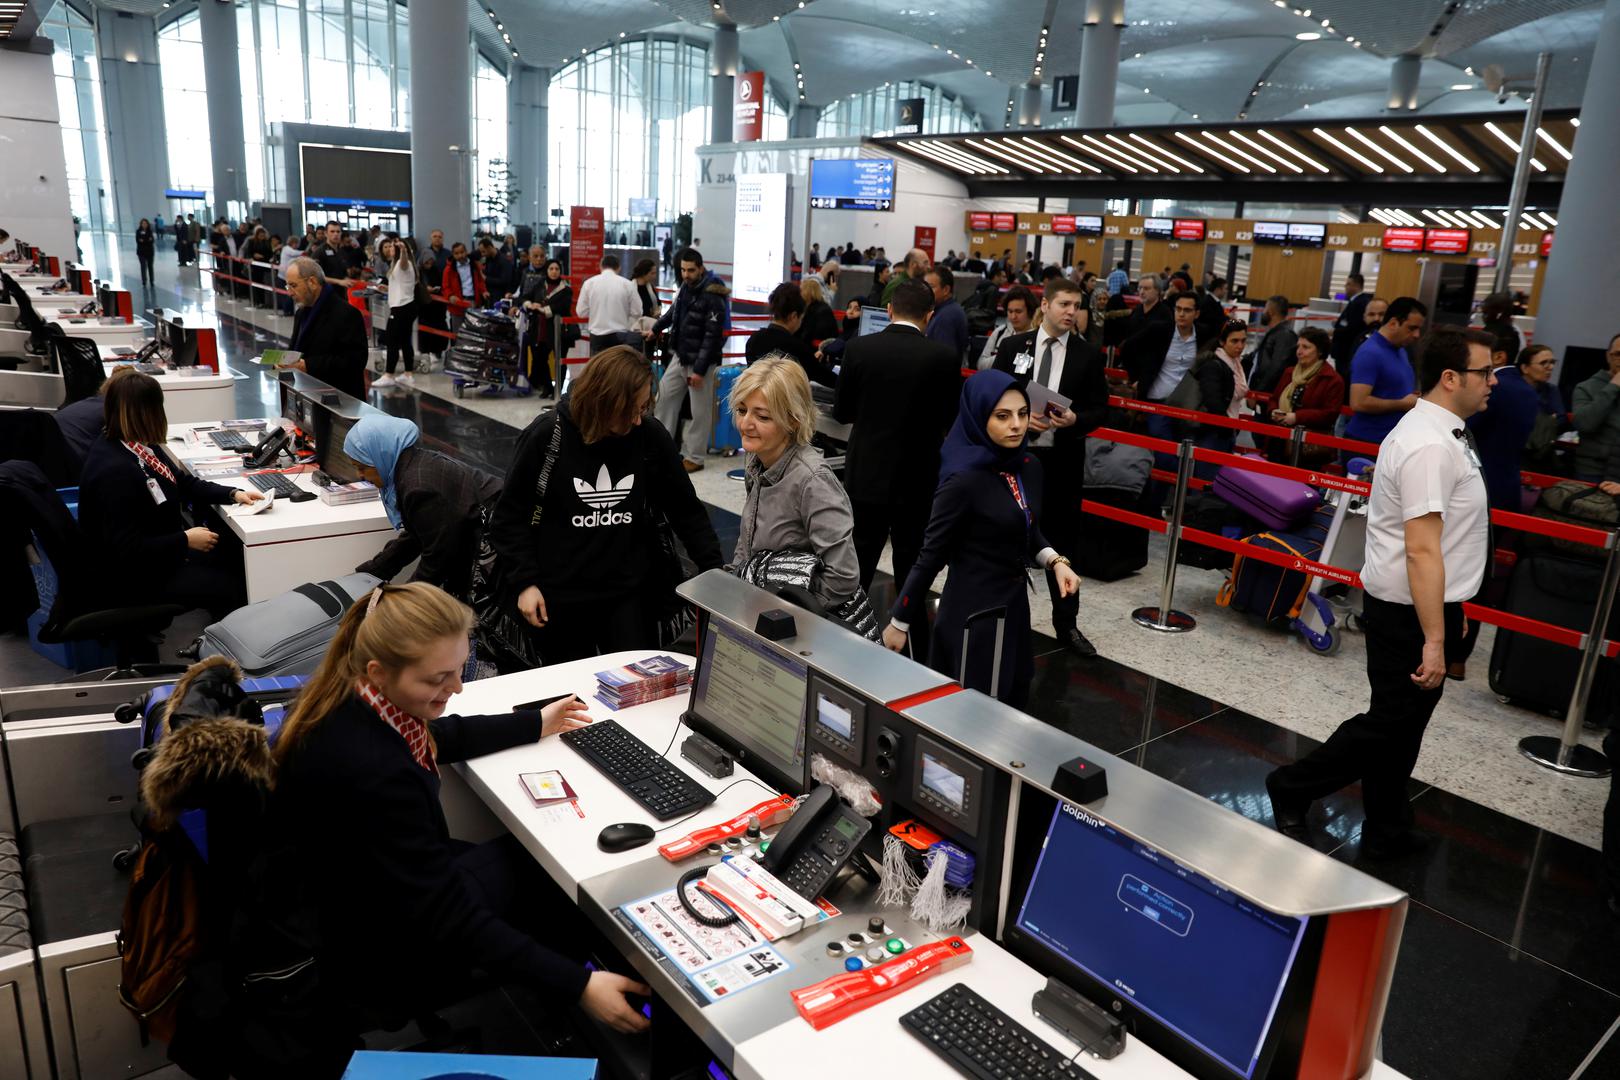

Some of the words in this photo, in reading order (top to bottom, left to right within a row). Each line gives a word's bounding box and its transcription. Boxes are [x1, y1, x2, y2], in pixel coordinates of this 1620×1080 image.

[1057, 80, 1070, 107] L
[701, 158, 713, 184] K
[1105, 226, 1120, 234] K26
[1129, 227, 1143, 235] K27
[1208, 230, 1224, 239] K28
[1236, 231, 1252, 240] K29
[1328, 235, 1348, 245] K30
[1362, 237, 1382, 247] K31
[1472, 242, 1496, 252] K32
[1514, 244, 1538, 254] K33
[1320, 478, 1343, 488] TURKISH
[1343, 483, 1368, 493] AIRLINES
[531, 505, 543, 525] PULL
[571, 509, 633, 528] adidas
[1305, 564, 1328, 575] TURKISH
[1328, 571, 1352, 582] AIRLINES
[1062, 803, 1099, 828] dolphin
